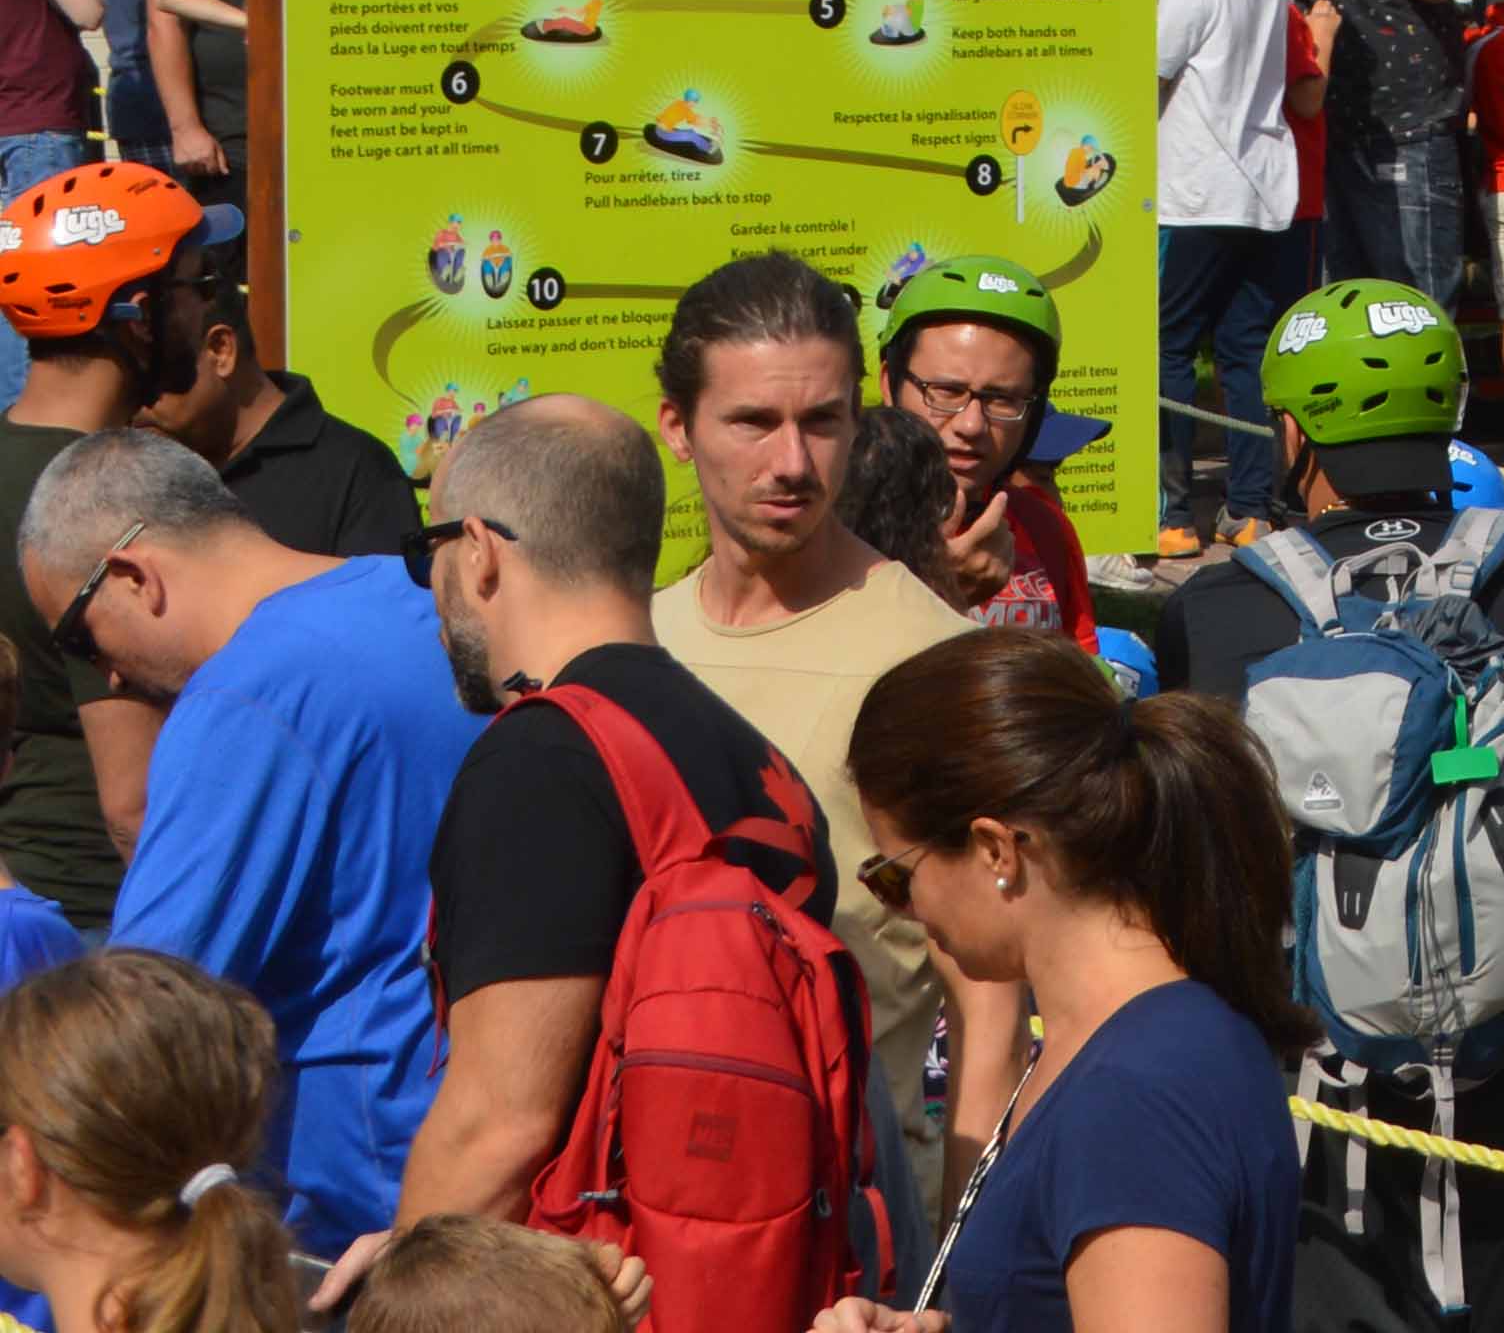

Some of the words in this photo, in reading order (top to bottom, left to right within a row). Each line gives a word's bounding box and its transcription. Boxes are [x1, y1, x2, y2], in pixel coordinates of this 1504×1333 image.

[451, 72, 467, 94] 6
[592, 134, 606, 156] 7
[911, 133, 961, 148] Respect
[964, 132, 996, 147] signs
[977, 164, 992, 185] 8
[53, 206, 125, 245] Luge
[531, 278, 558, 298] 10
[1367, 302, 1439, 336] Luge
